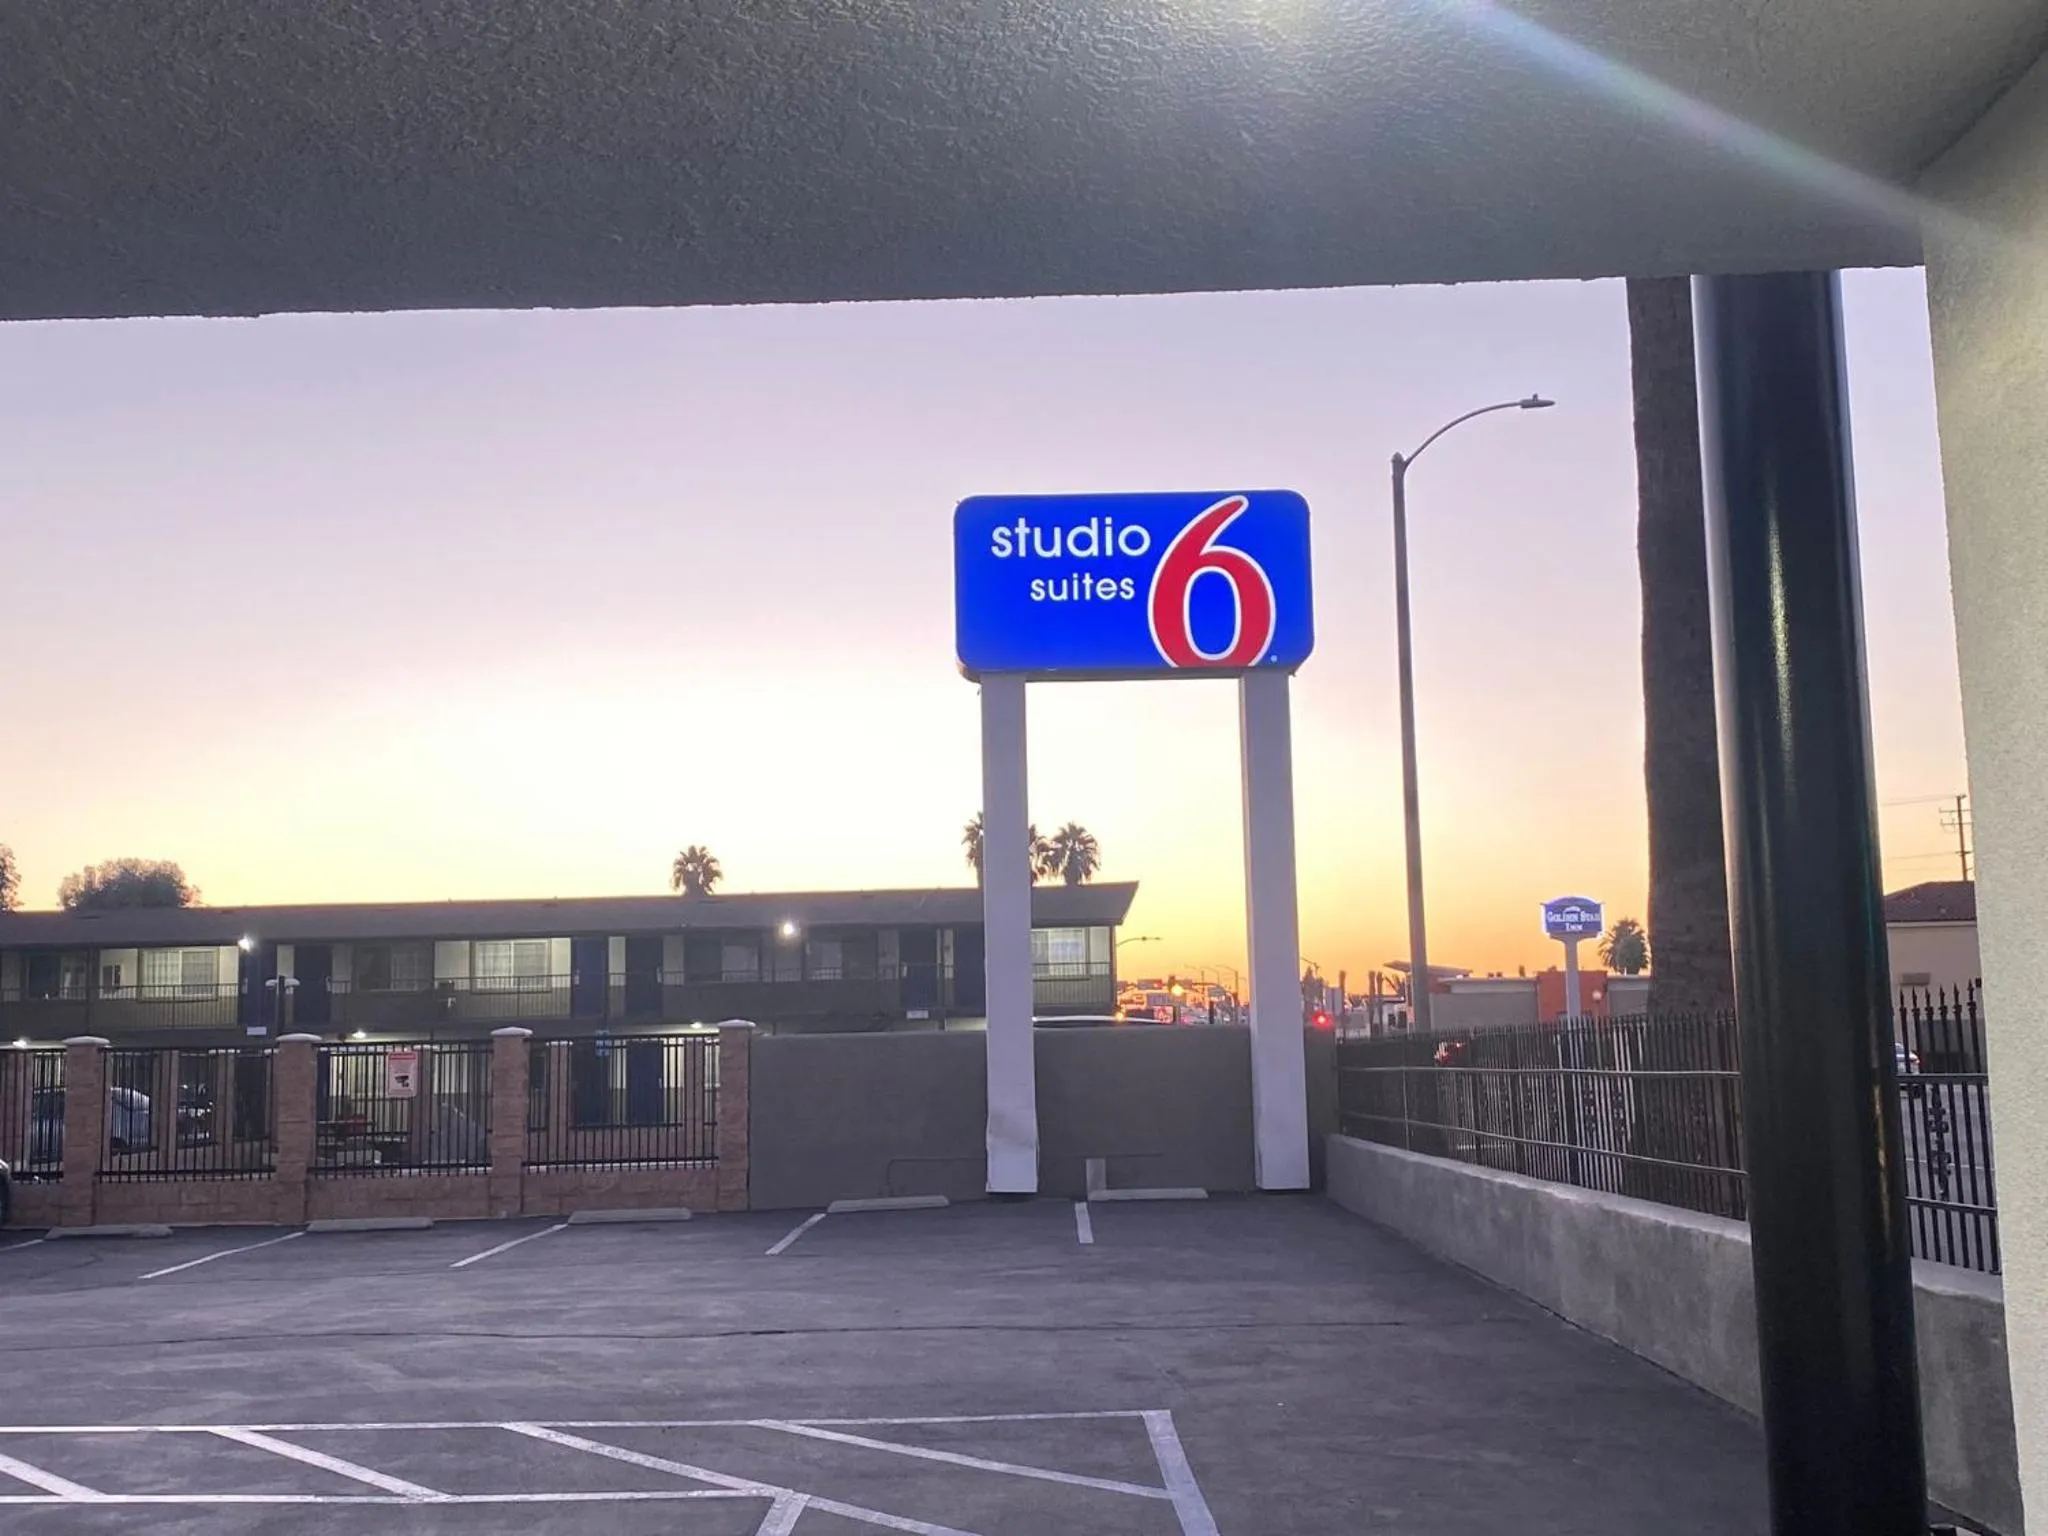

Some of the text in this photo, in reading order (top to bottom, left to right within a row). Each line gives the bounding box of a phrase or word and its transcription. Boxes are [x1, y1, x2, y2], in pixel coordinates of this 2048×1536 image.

[990, 494, 1277, 668] studio 6
[1029, 572, 1136, 602] suites
